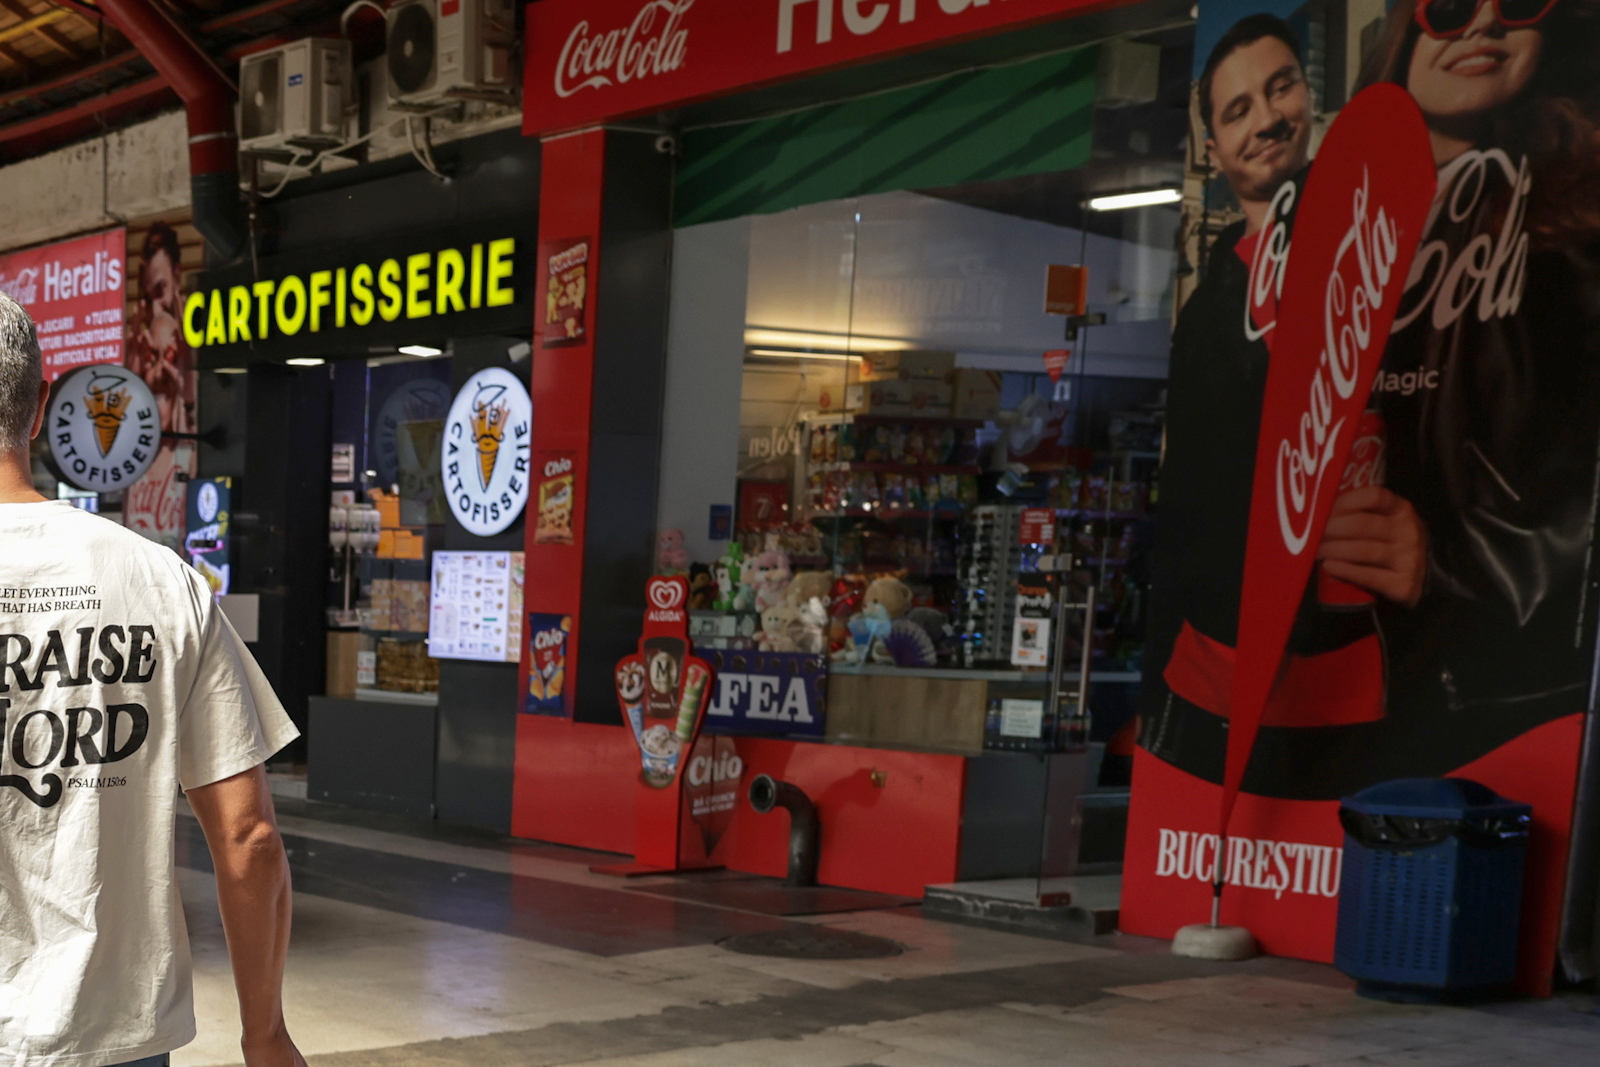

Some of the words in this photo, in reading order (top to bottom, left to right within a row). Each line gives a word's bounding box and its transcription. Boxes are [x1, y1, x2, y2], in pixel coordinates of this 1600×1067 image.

[554, 0, 694, 98] Coca-Cola
[44, 251, 122, 302] Heralis
[182, 237, 516, 349] CARTOFISSERIE
[1276, 162, 1399, 556] Coca-Cola
[56, 401, 154, 484] CARTOFISSERIE
[448, 420, 530, 524] CARTOFISSERIE
[19, 585, 96, 599] EVERYTHING
[27, 601, 52, 613] HAS
[54, 599, 102, 611] BREATH
[649, 611, 682, 622] ALGIDA
[707, 671, 814, 724] FEA
[67, 778, 106, 788] PSALM
[689, 751, 743, 787] Chio
